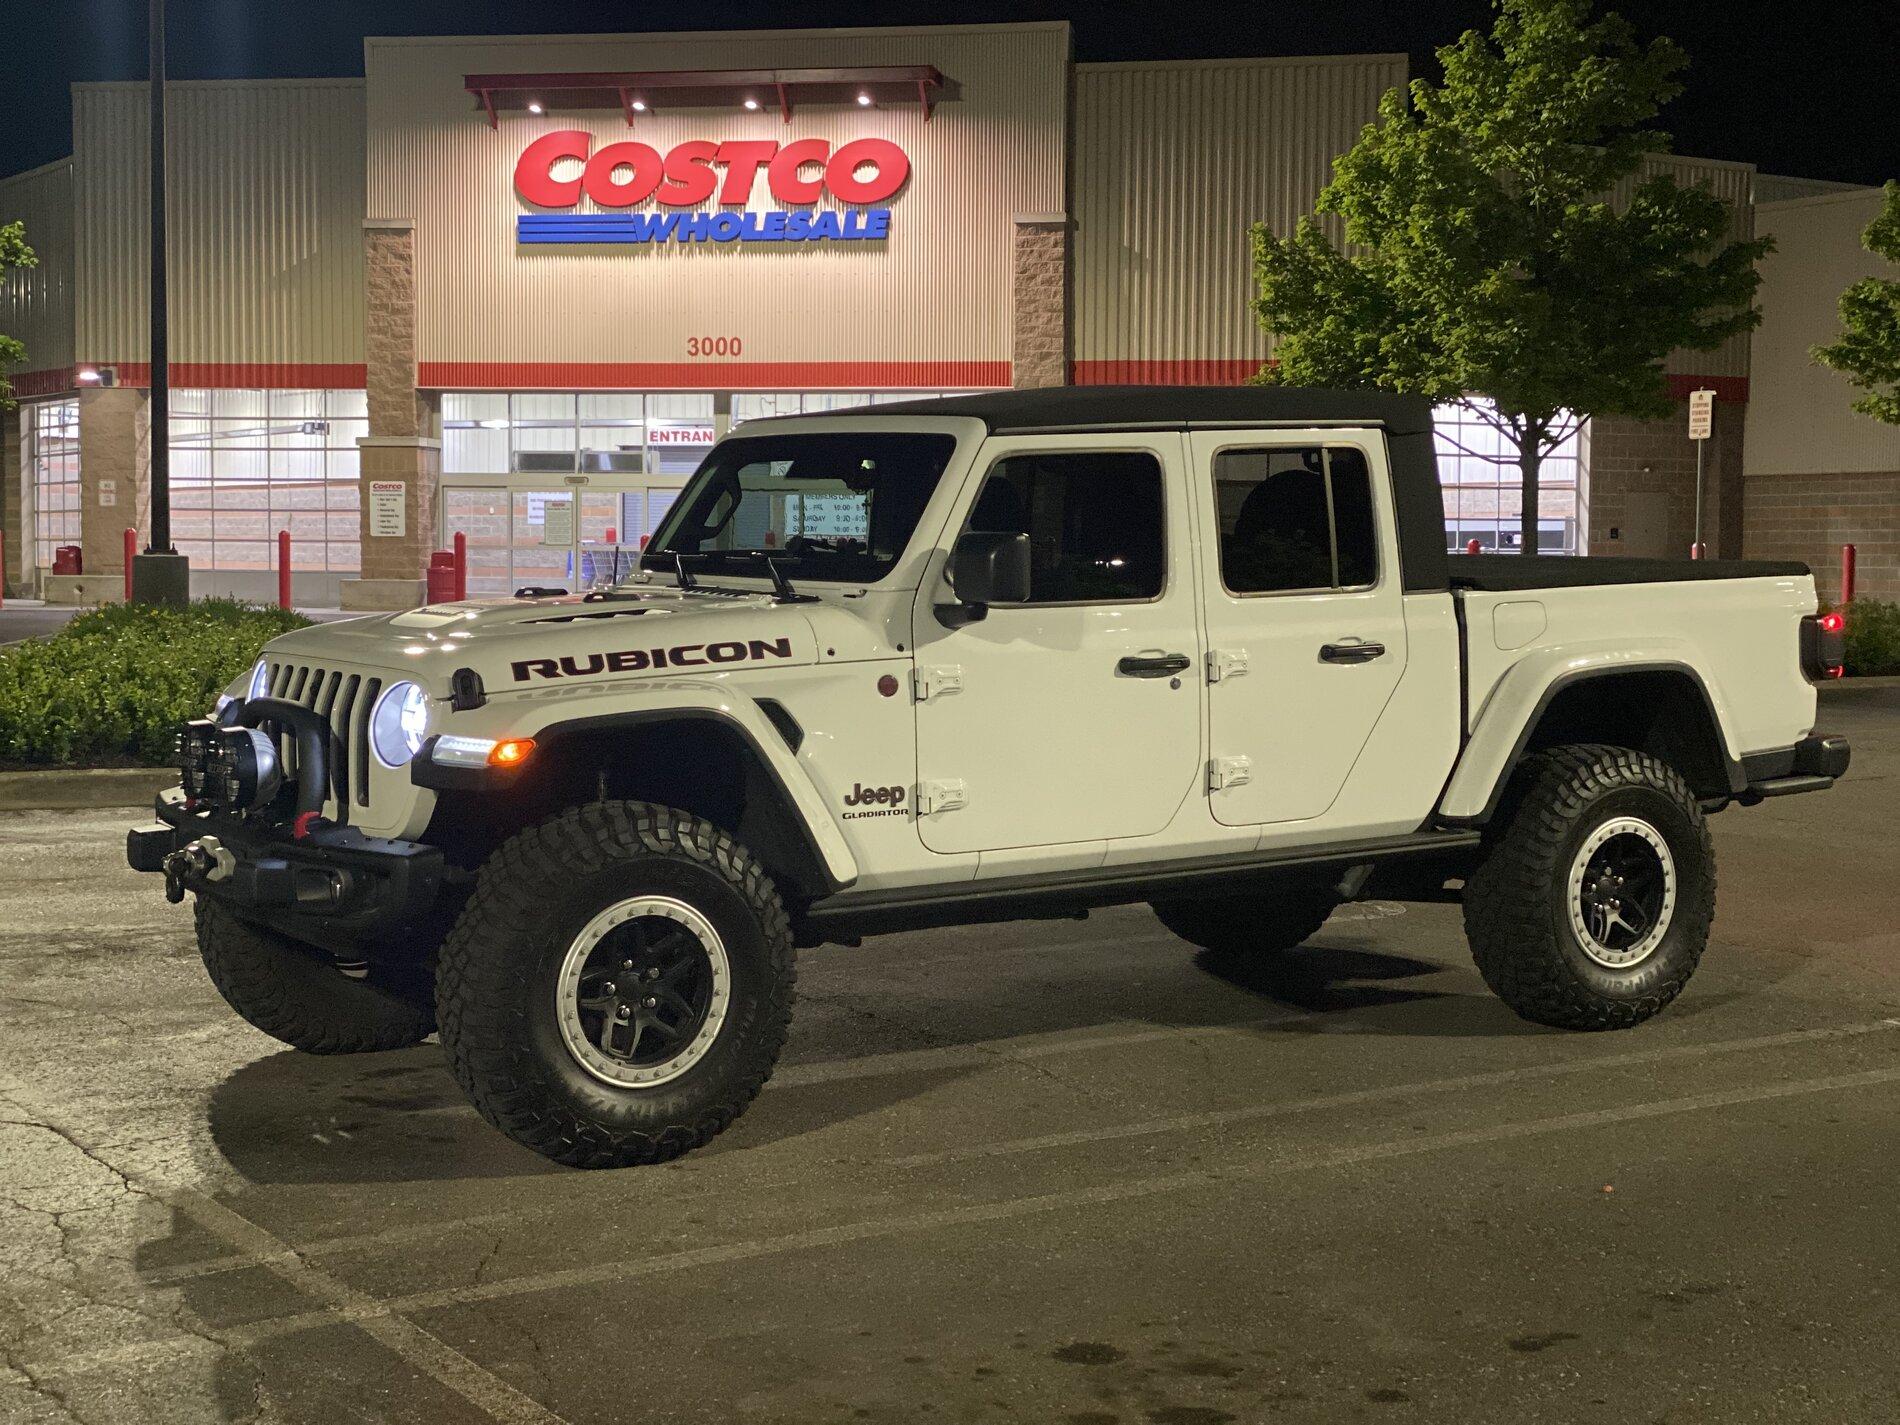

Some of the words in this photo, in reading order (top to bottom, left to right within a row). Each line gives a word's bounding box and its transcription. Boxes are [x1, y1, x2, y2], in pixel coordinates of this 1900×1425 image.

[514, 130, 909, 207] COSTCO
[633, 209, 890, 242] WHOLESALE
[687, 337, 742, 356] 3000
[510, 638, 793, 682] RUBICON
[844, 783, 905, 807] Jeep
[842, 808, 909, 819] GLADIATOR
